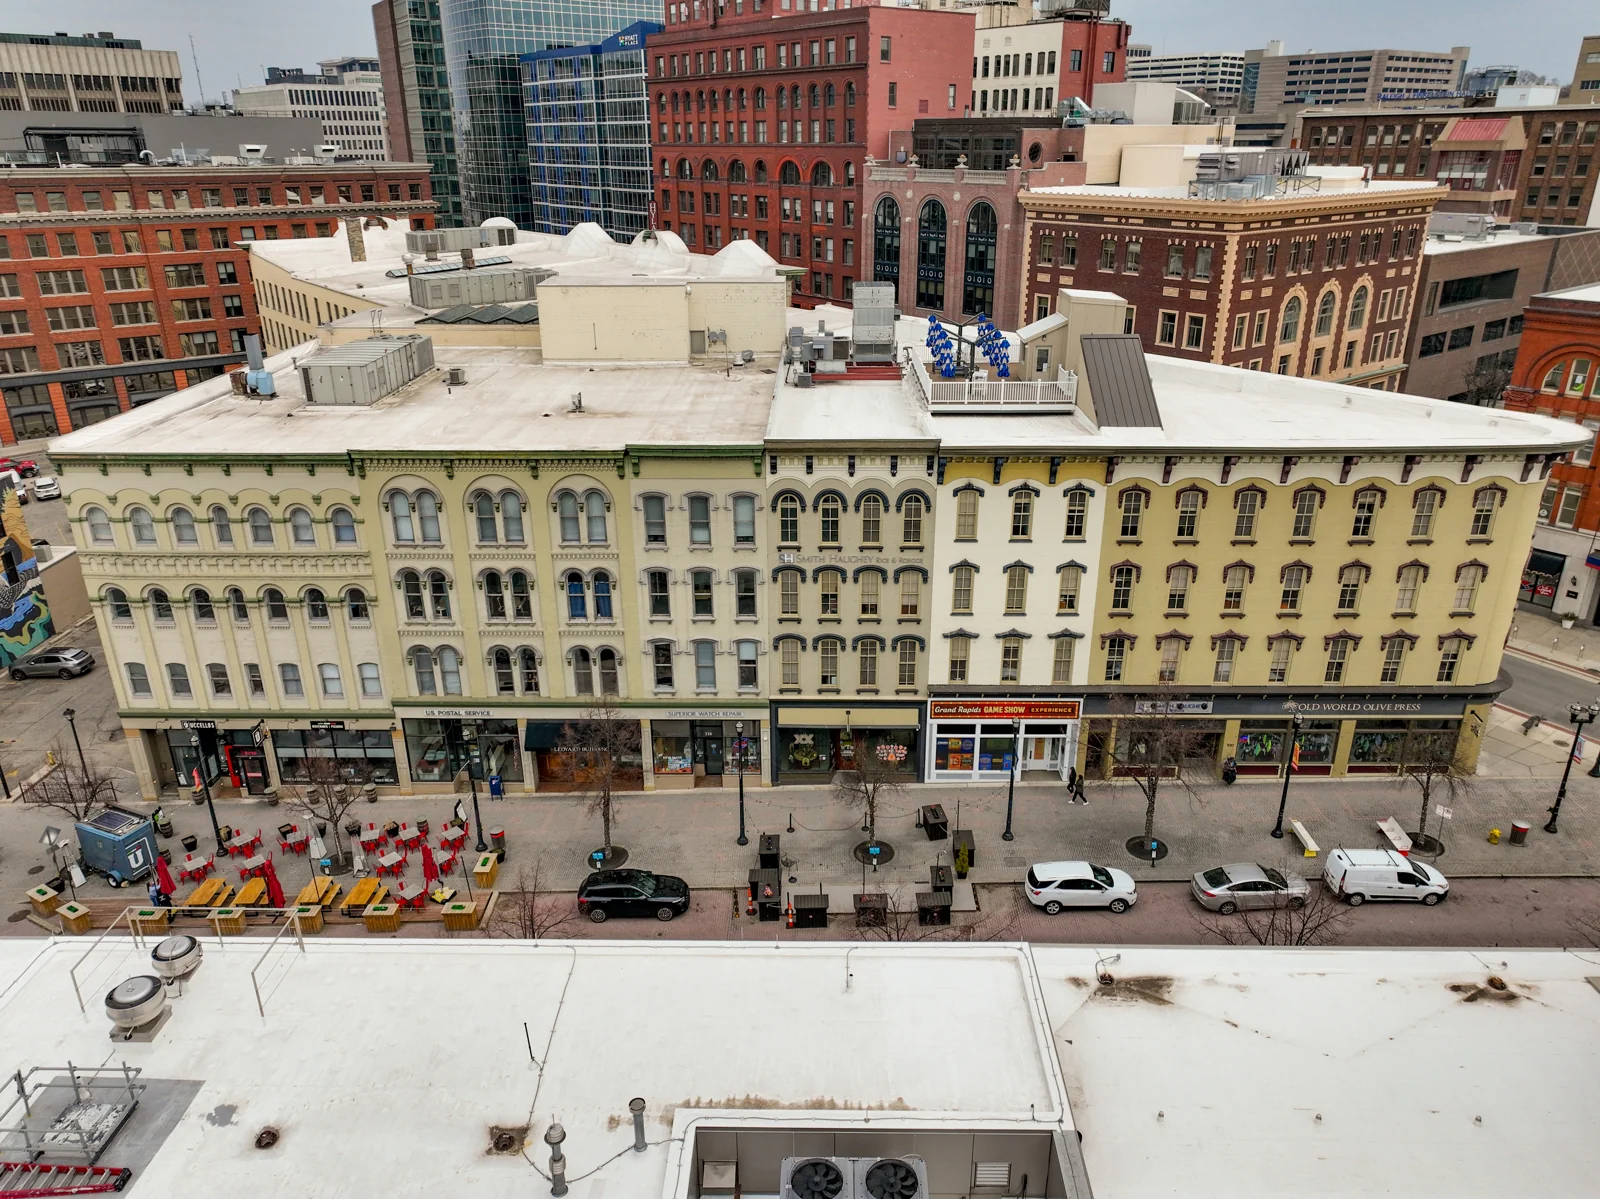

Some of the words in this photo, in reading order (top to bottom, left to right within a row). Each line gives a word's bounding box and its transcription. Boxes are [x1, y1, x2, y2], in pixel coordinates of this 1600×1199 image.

[796, 554, 826, 564] SMITH
[830, 554, 873, 564] HAUGHEY
[958, 706, 982, 714] Rapids
[1298, 703, 1320, 711] OLD
[1322, 703, 1361, 711] WORLD
[1363, 703, 1393, 711] OLIVE
[1394, 703, 1421, 711] PRESS
